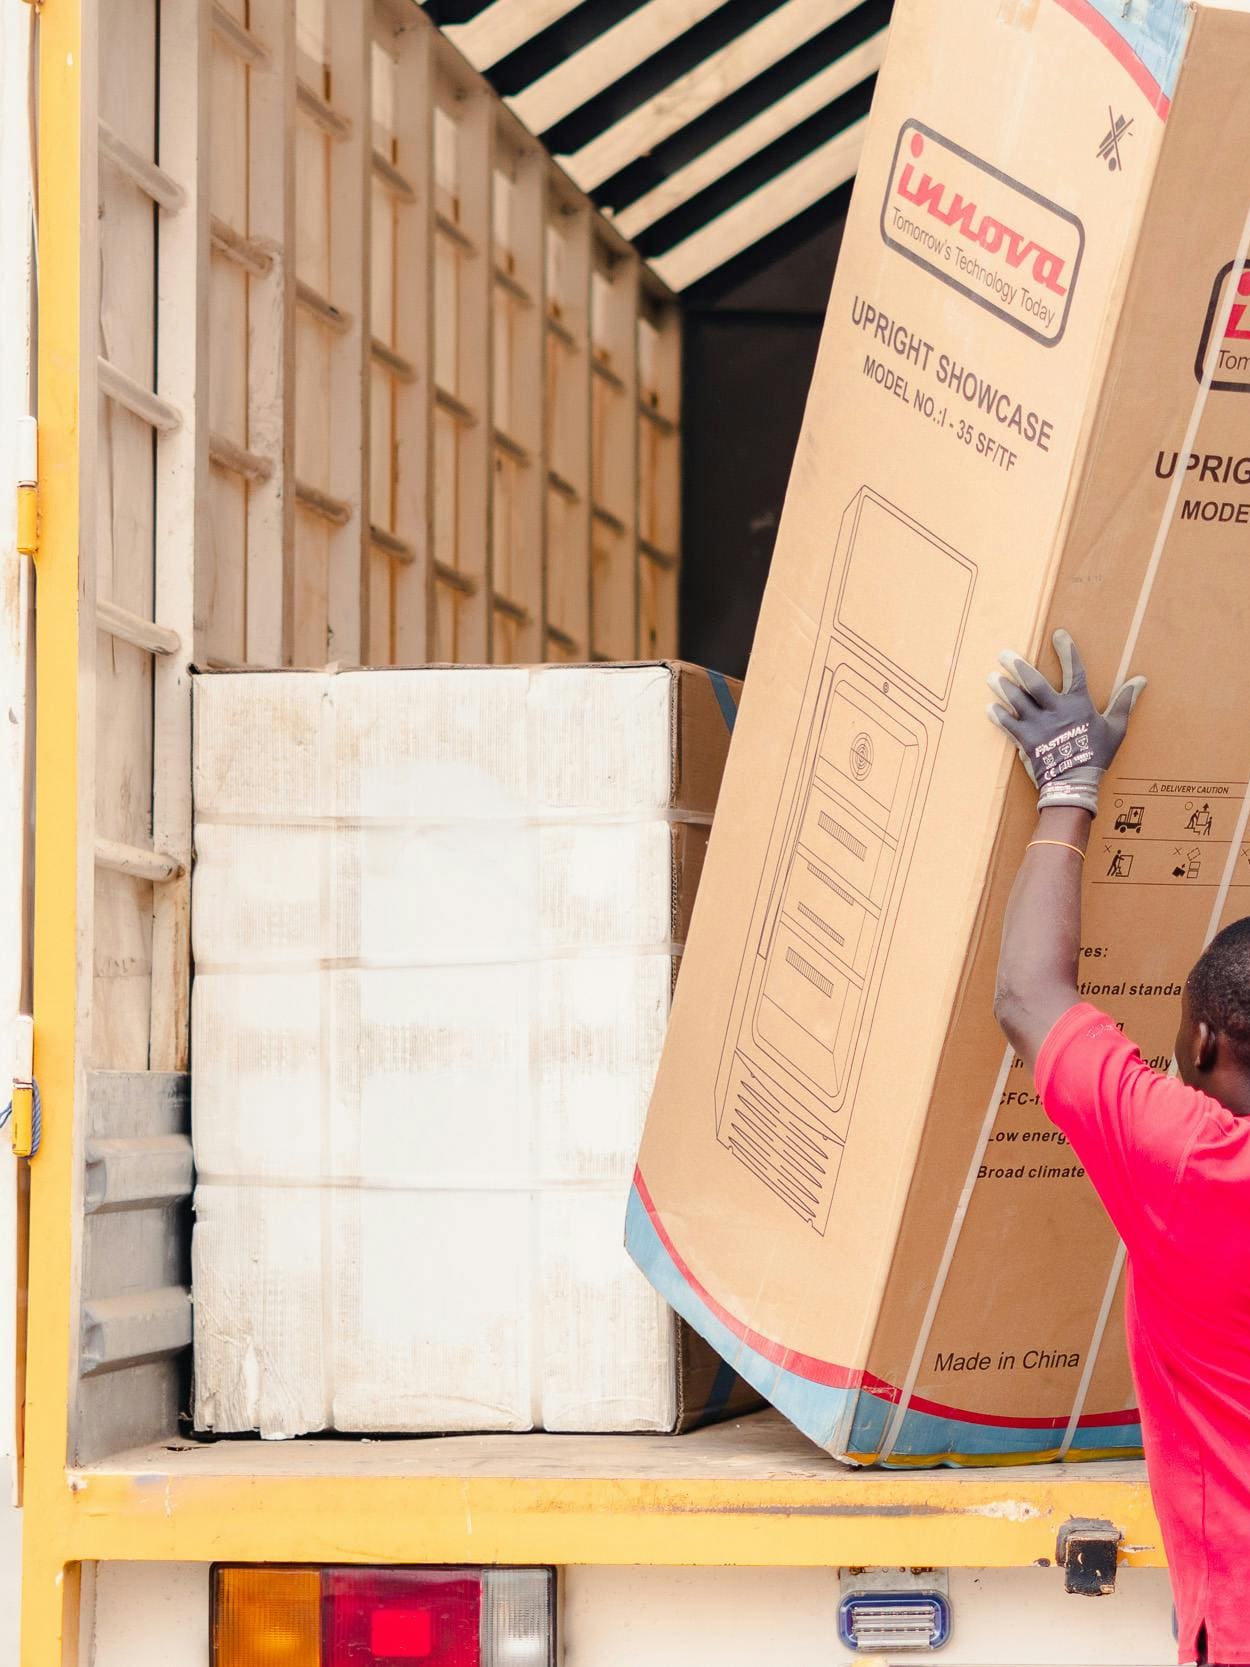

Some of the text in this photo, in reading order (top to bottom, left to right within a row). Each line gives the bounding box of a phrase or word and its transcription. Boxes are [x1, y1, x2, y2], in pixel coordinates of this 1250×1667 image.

[897, 133, 1067, 296] innova
[892, 206, 1056, 328] Tomorrow's Technology Today
[851, 296, 1054, 453] UPRIGHT SHOWCASE
[863, 355, 909, 404] MODEL
[956, 419, 974, 445] 35
[976, 432, 1018, 471] SF/TF
[1035, 723, 1088, 758] FASTENAL
[1160, 783, 1229, 795] DELIVERY CAUTION
[1077, 982, 1182, 996] tional standa
[988, 1131, 1070, 1145] ow energ
[976, 1165, 1085, 1179] Broad climate
[934, 1349, 1081, 1372] Made in China
